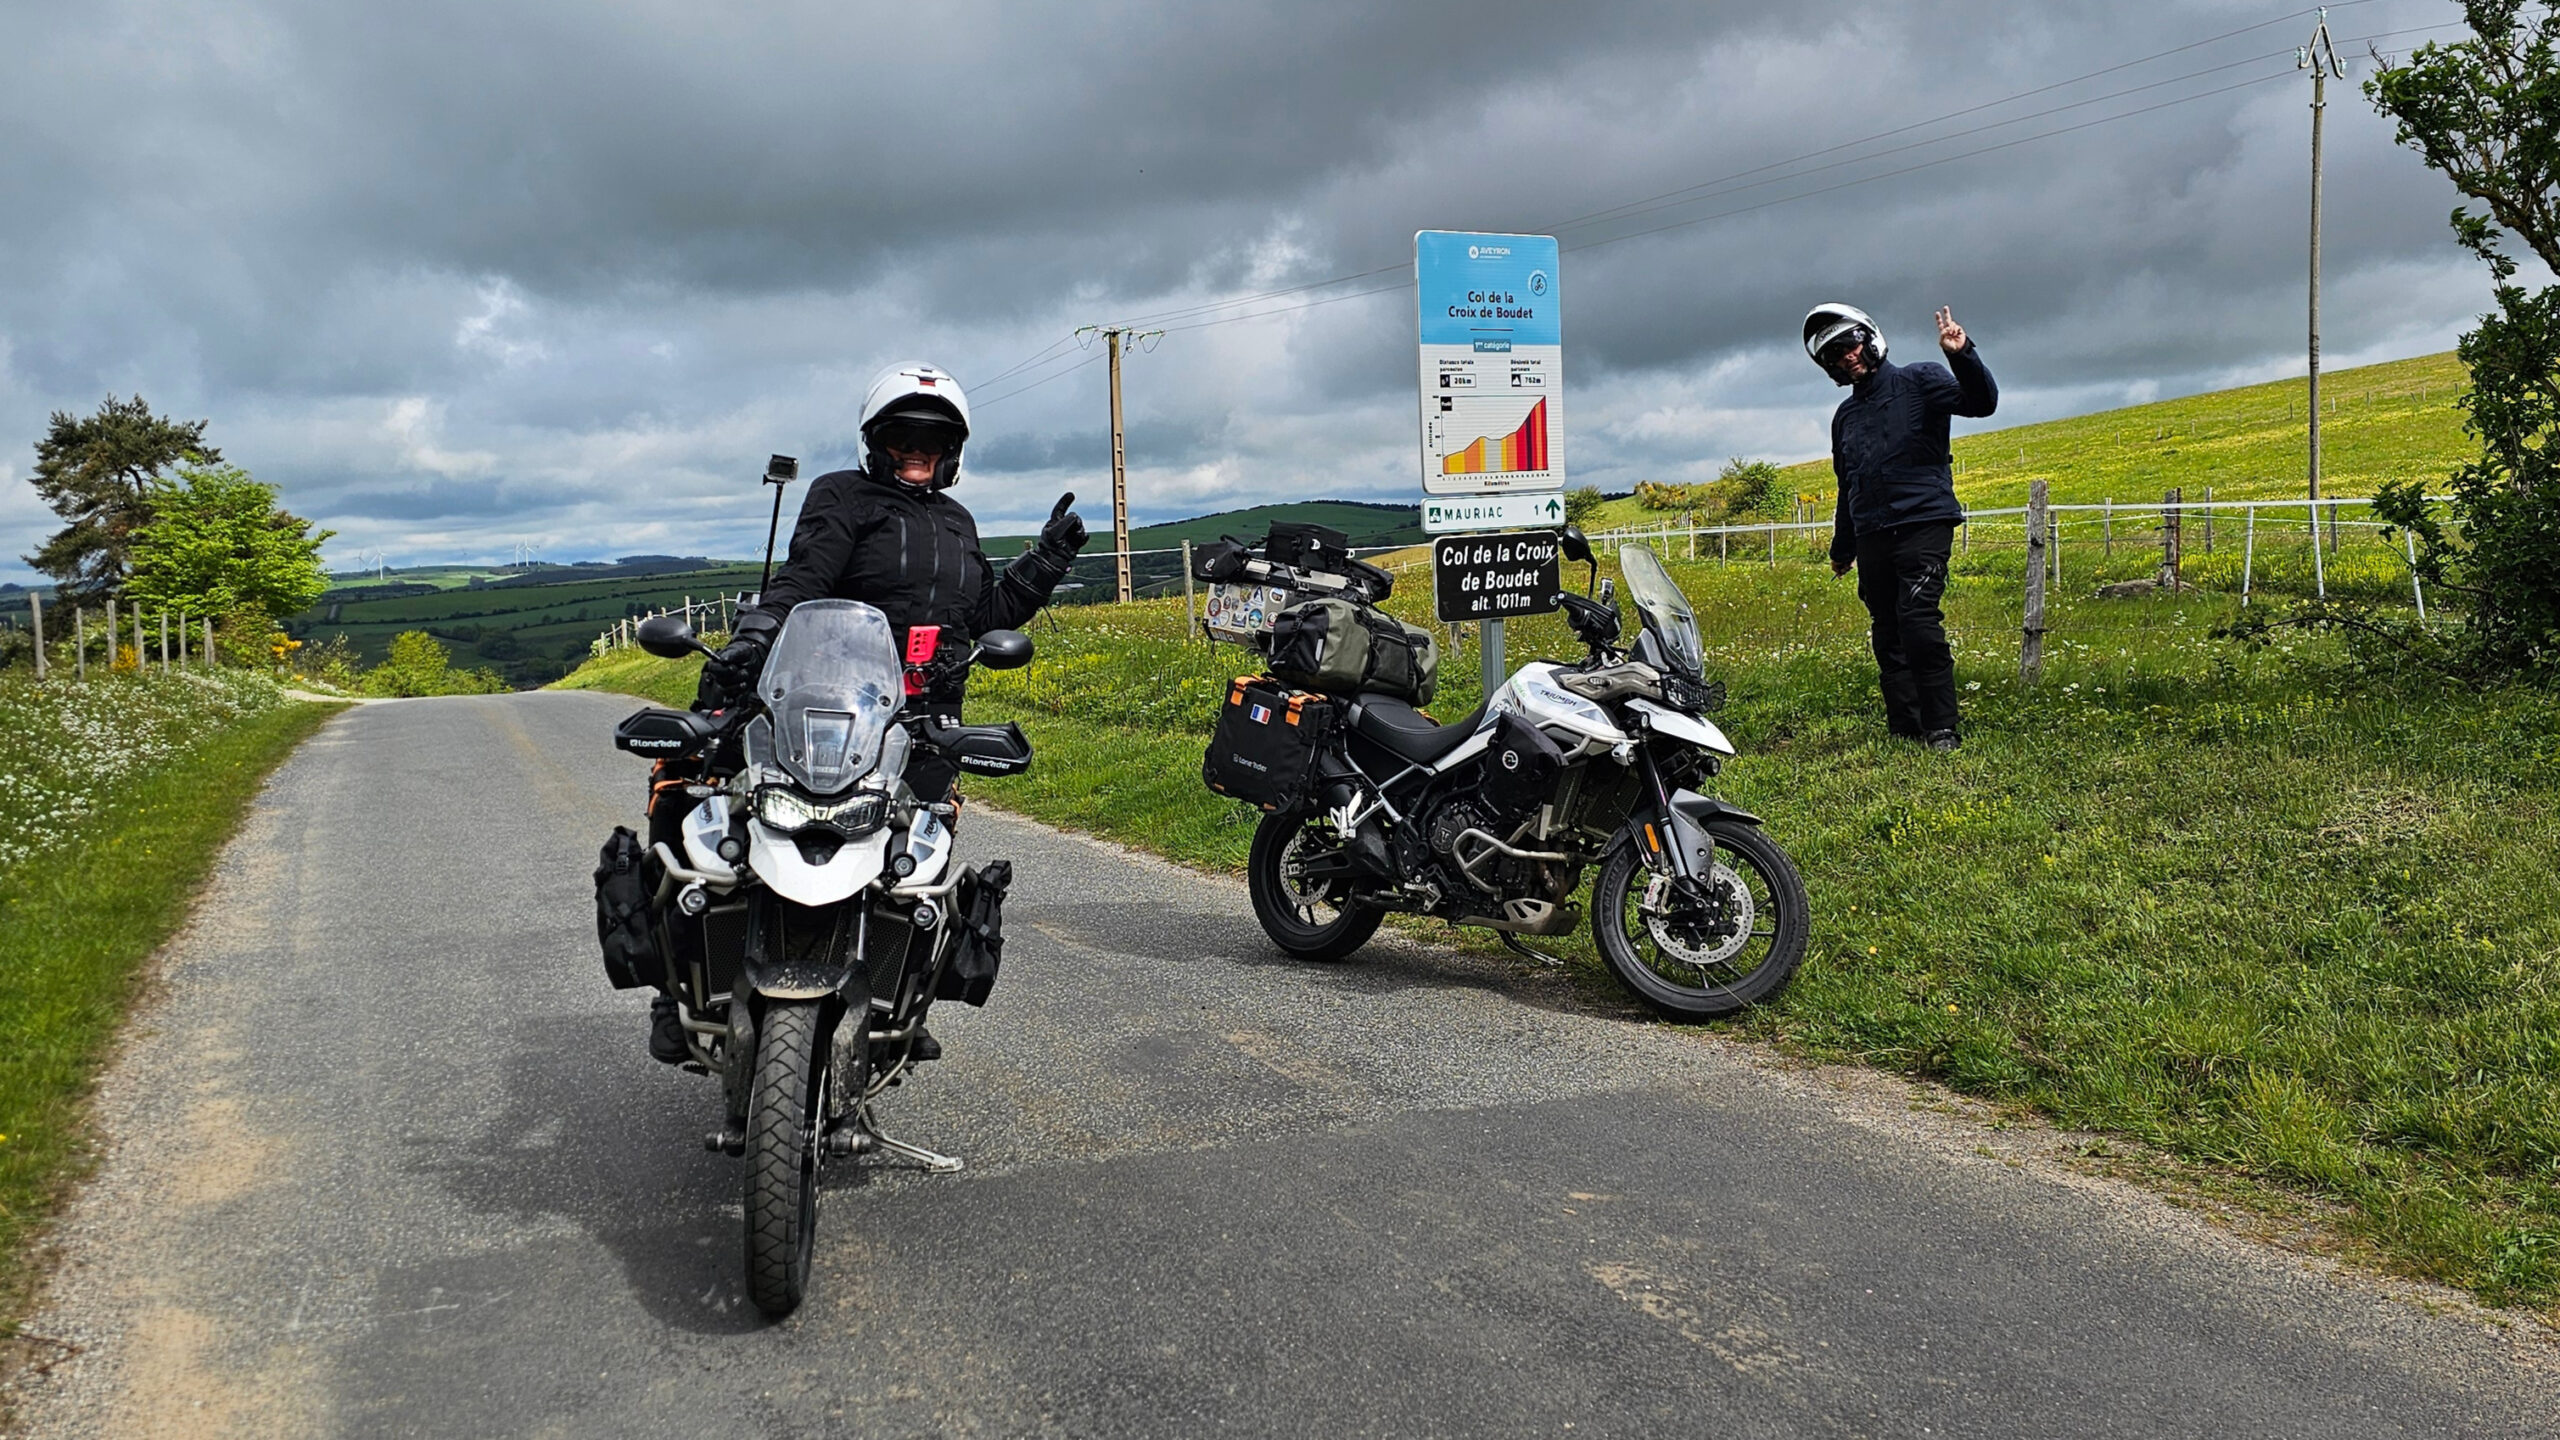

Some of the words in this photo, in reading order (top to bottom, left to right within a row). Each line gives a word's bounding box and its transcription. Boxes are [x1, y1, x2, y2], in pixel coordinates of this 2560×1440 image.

[1480, 247, 1511, 255] AVEYRON
[1468, 291, 1485, 303] Col
[1489, 291, 1501, 303] de
[1505, 291, 1514, 303] la
[1448, 305, 1477, 318] Croix
[1480, 306, 1493, 318] de
[1496, 307, 1533, 319] Boudet
[1444, 506, 1503, 521] MAURIAC
[1534, 504, 1539, 516] 1
[1442, 545, 1469, 566] Col
[1473, 544, 1491, 564] de
[1497, 543, 1510, 563] la
[1515, 541, 1555, 561] Croix
[1461, 572, 1480, 591] de
[1485, 568, 1539, 590] Boudet
[1471, 596, 1491, 611] alt.
[1496, 593, 1531, 609] 1011m
[1540, 689, 1578, 706] TRIUMPH
